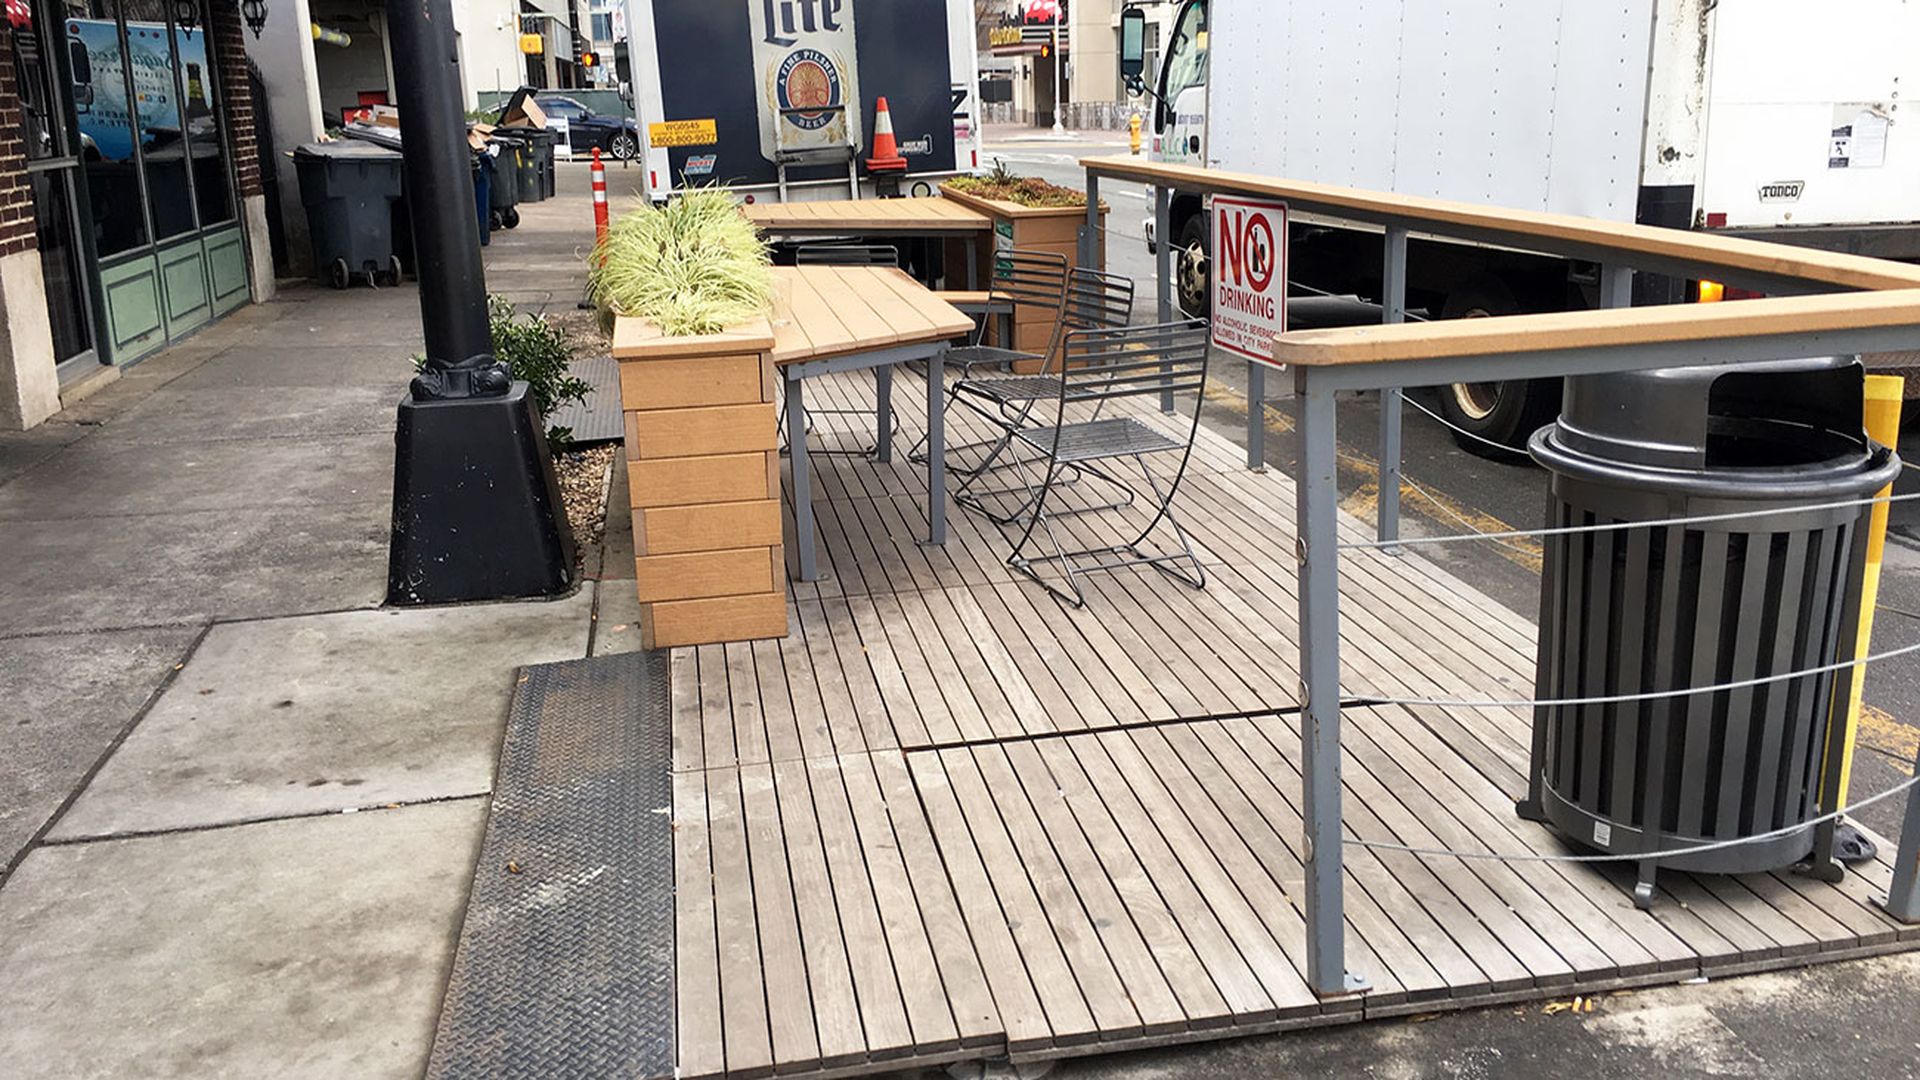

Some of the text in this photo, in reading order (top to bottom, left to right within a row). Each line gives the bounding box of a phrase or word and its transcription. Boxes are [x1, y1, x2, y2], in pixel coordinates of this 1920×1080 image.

[782, 54, 801, 75] FINE
[803, 50, 837, 83] PILSNER
[798, 117, 827, 129] BEER
[1761, 185, 1799, 198] TODCO
[1220, 209, 1275, 293] NO
[1219, 285, 1275, 321] DRINKING
[1223, 316, 1248, 333] ALCOHOLIC
